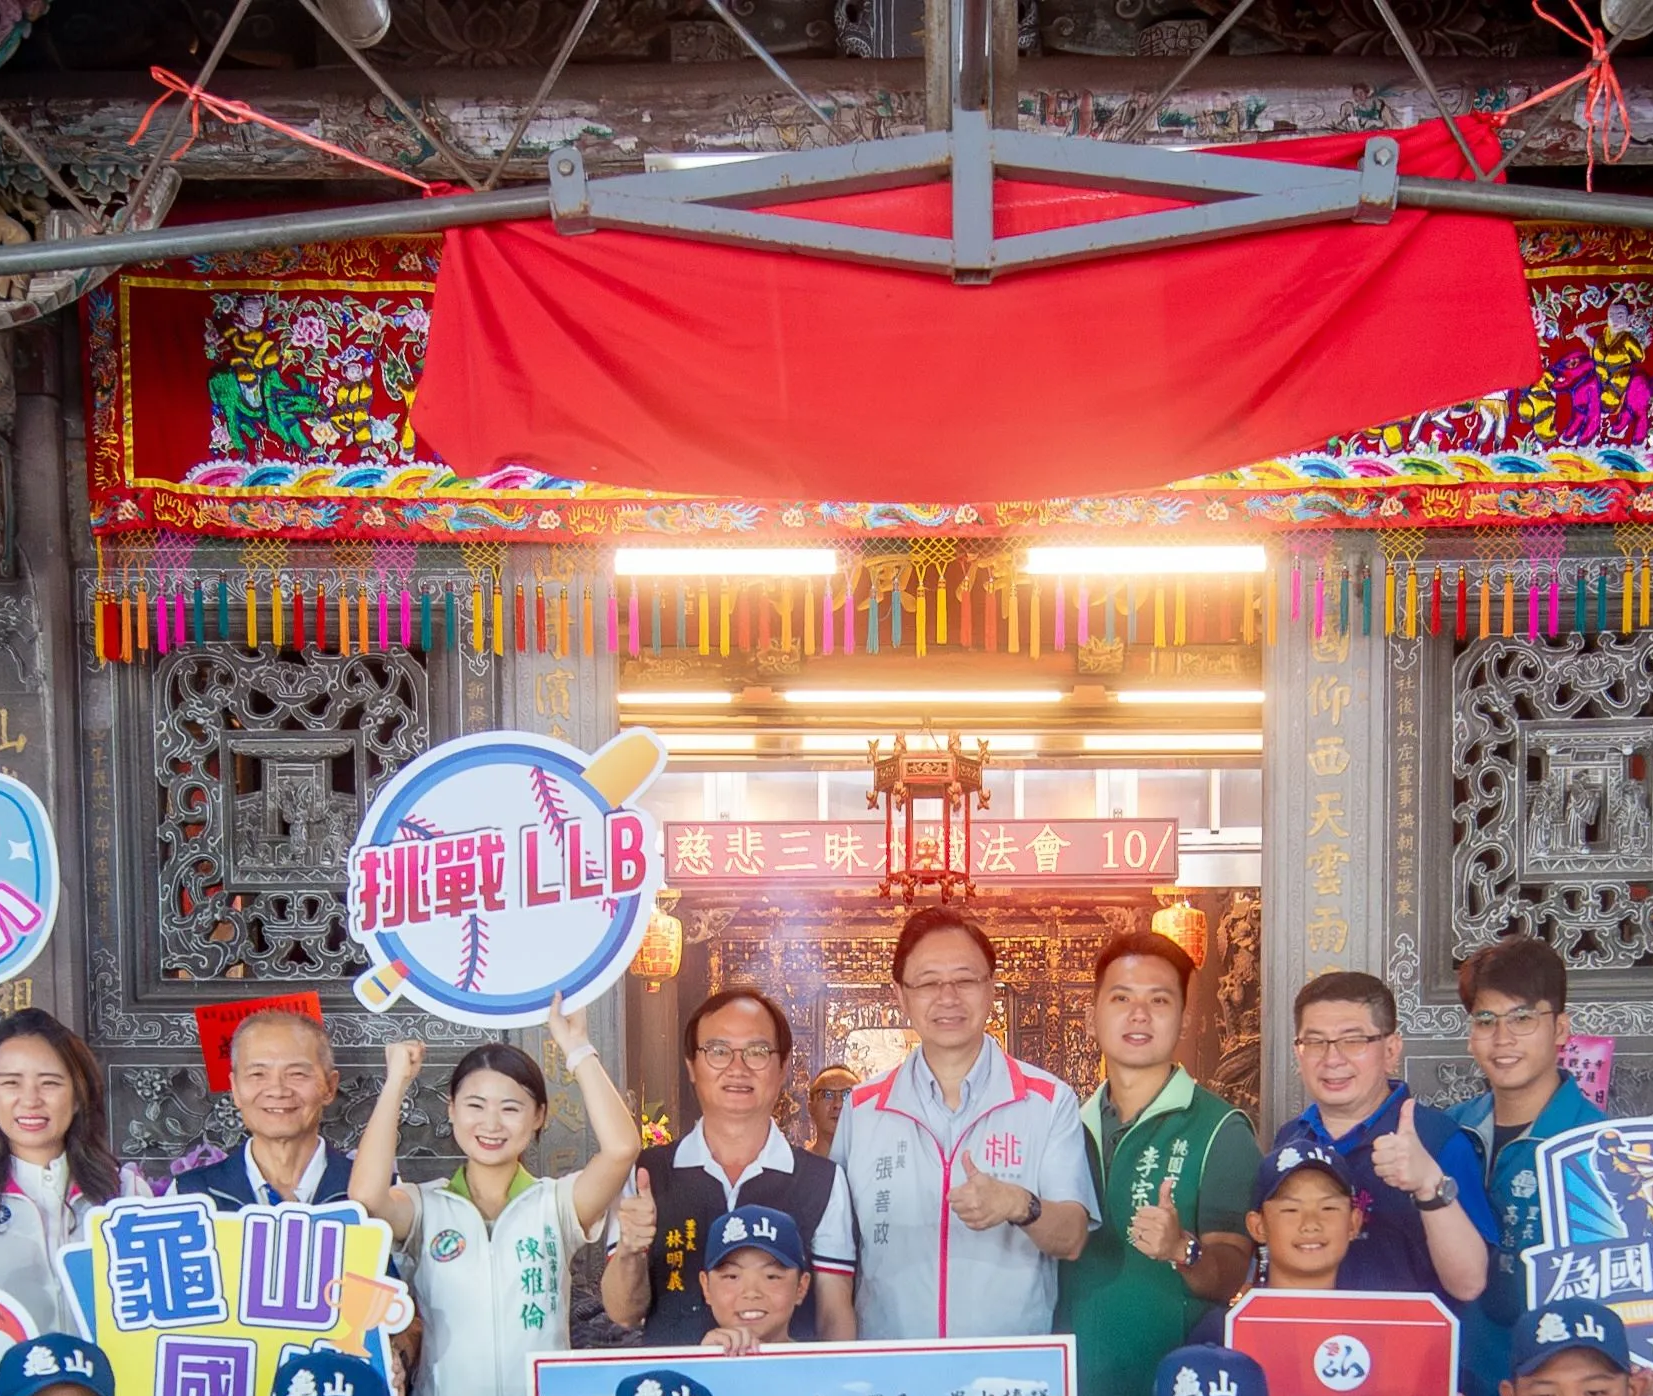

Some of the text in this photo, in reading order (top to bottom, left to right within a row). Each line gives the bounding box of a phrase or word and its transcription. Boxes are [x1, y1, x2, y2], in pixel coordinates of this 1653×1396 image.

[359, 815, 647, 932] 挑戰 LLB
[874, 1154, 894, 1246] 張善政
[895, 1139, 908, 1170] 市長
[109, 1210, 342, 1328] 龜山
[515, 1236, 547, 1332] 陳雅倫
[665, 1230, 686, 1292] 林明義
